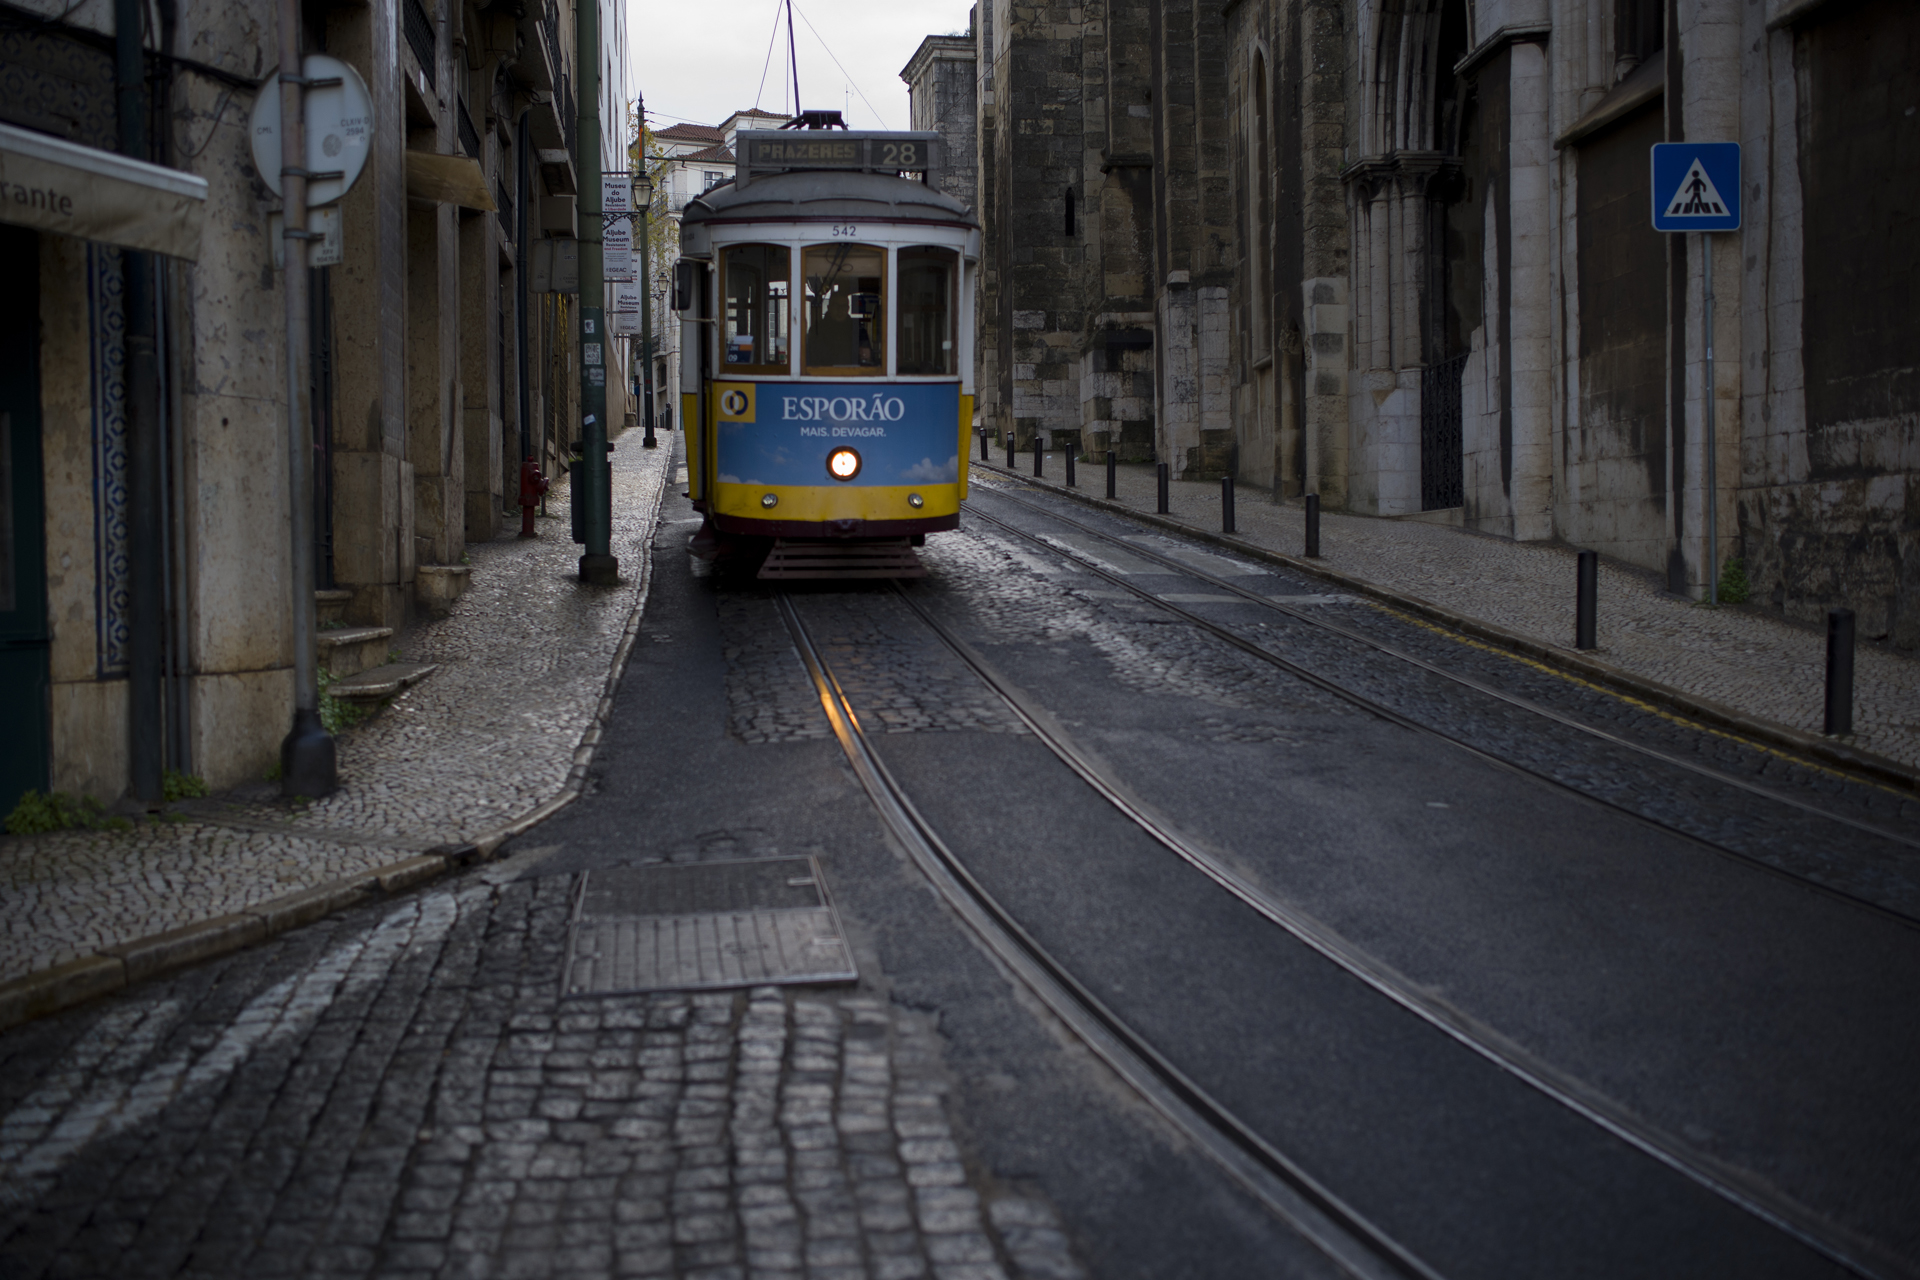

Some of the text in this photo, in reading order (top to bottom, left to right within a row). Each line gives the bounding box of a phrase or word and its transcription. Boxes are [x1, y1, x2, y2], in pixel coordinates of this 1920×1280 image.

[256, 126, 273, 135] CML
[346, 126, 364, 136] 2594
[758, 143, 856, 159] PRAZERES
[883, 143, 917, 165] 28
[605, 196, 626, 204] Aljube
[605, 229, 627, 237] Aljube
[832, 225, 857, 237] 542
[727, 353, 738, 362] 09
[781, 392, 905, 421] ESPORÃO
[800, 426, 887, 438] MAIS. DEVAGAR.
